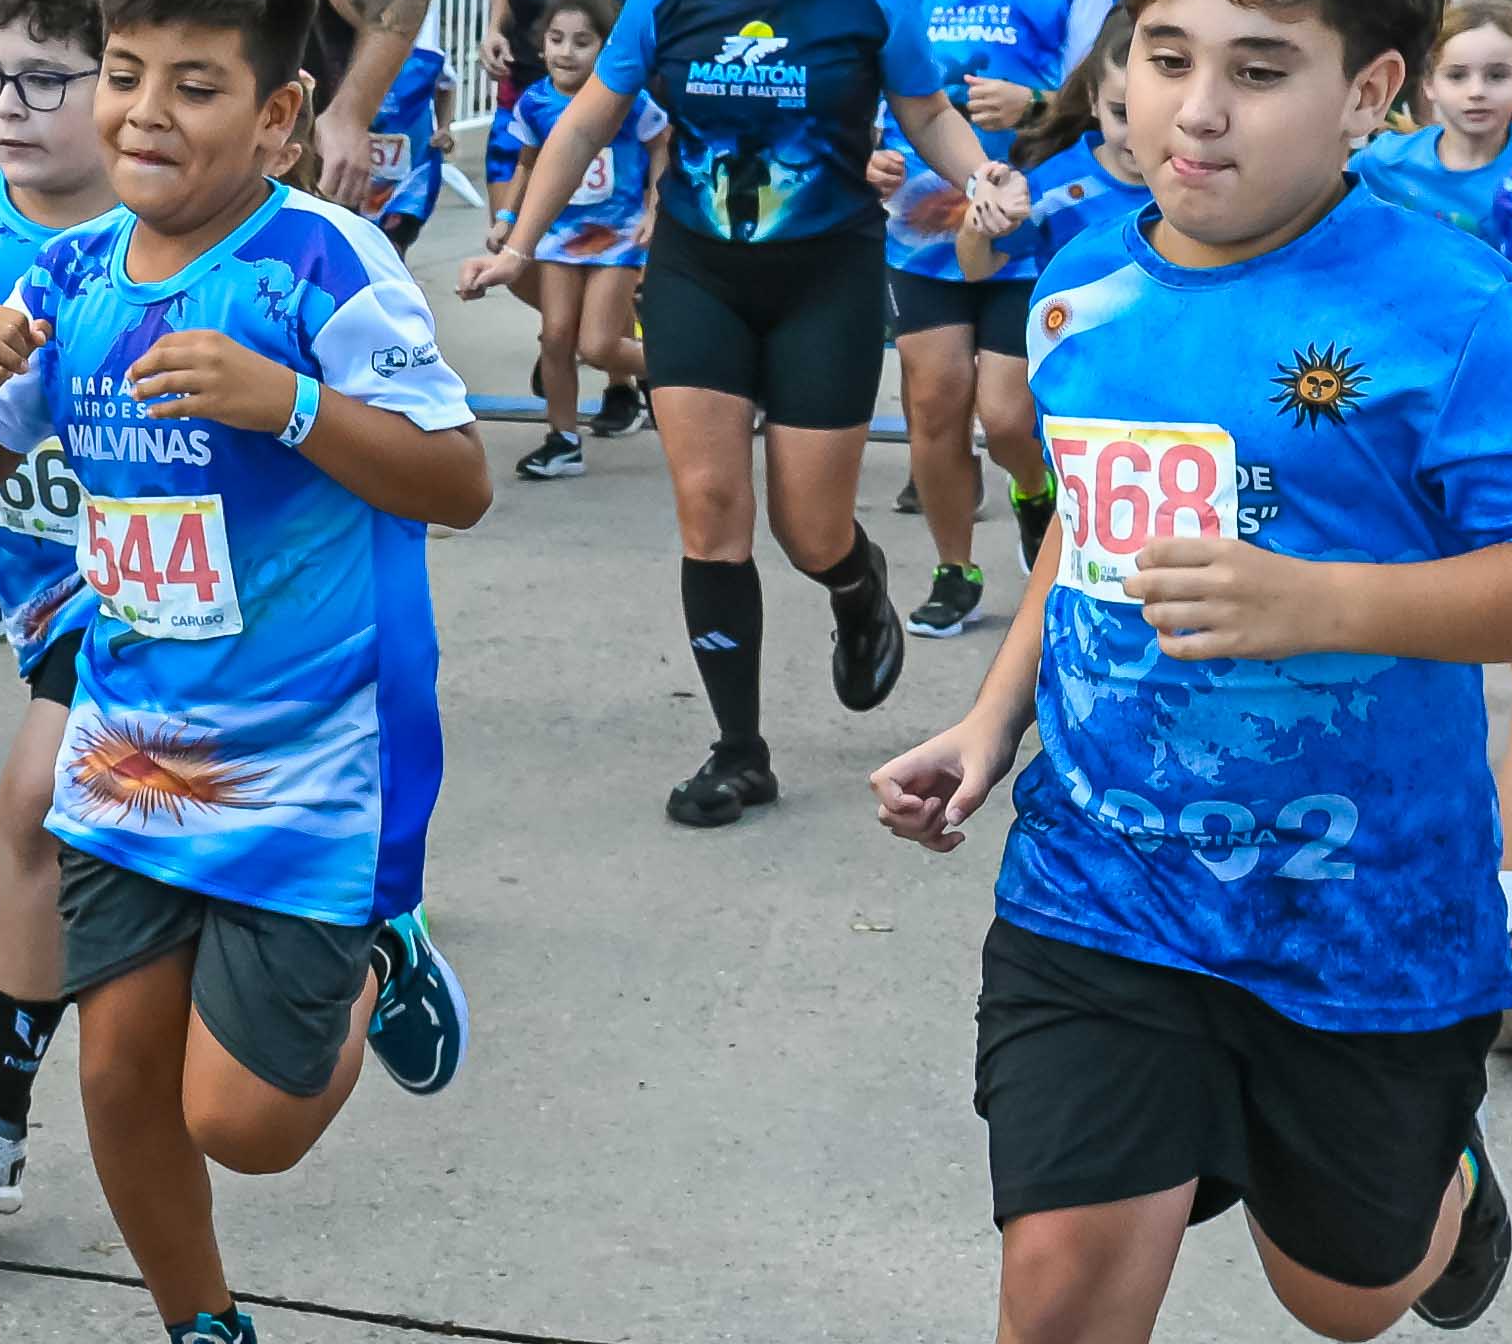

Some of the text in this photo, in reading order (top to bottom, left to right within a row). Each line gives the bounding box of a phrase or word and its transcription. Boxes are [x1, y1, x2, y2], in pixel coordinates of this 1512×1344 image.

[688, 60, 806, 84] MARATÓN
[68, 423, 211, 467] MALVINAS
[1051, 437, 1221, 555] 568
[86, 505, 221, 602] 544
[170, 614, 225, 627] CARUSO
